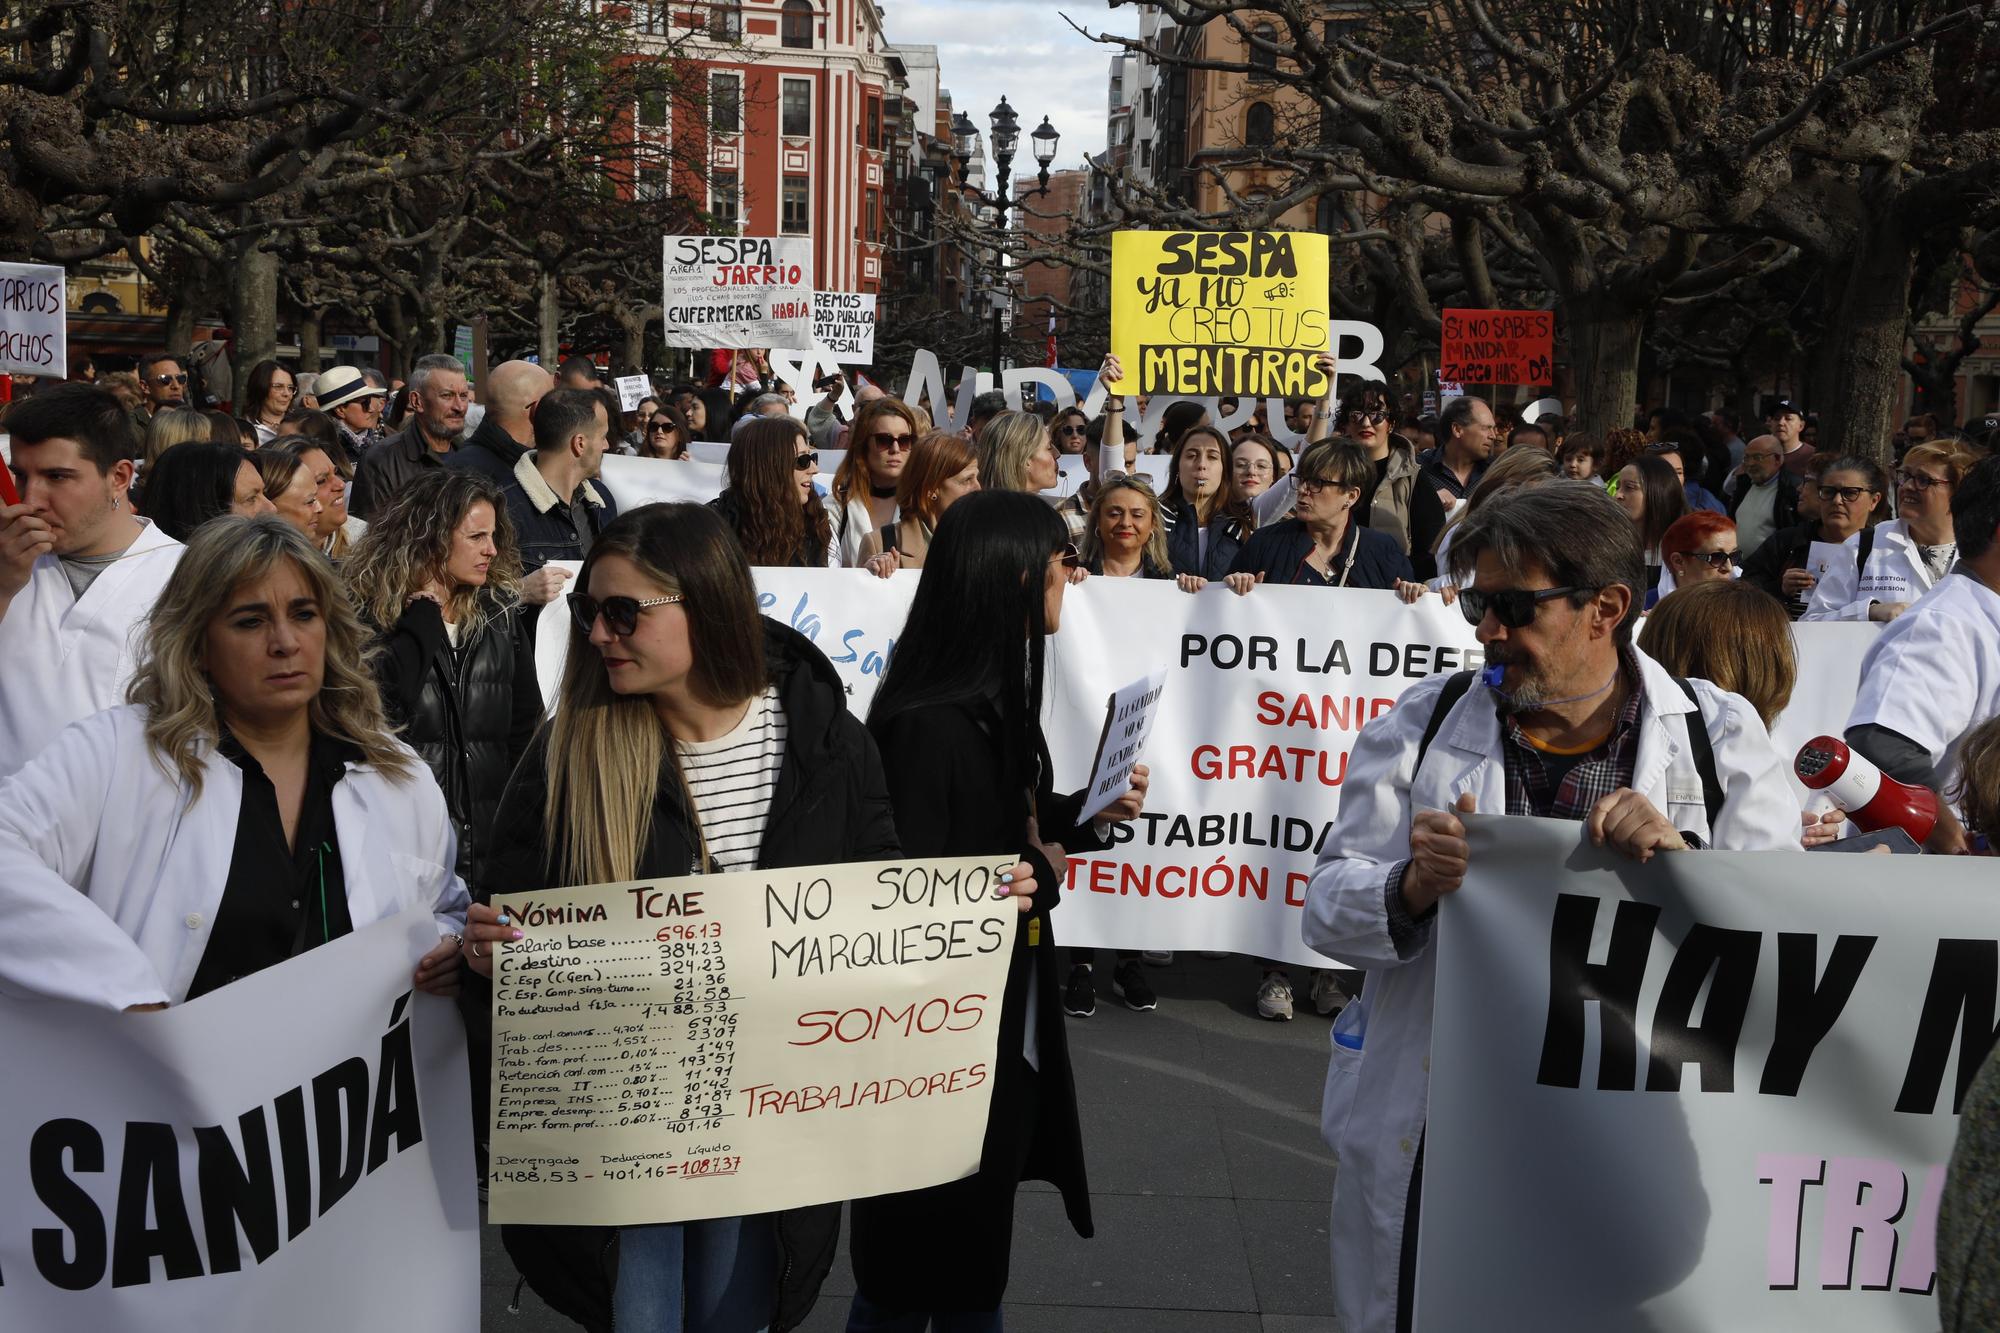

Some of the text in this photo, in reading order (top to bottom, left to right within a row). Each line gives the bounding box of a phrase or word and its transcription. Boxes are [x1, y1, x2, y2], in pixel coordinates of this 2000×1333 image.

[674, 238, 773, 266] SESPA
[1156, 232, 1298, 278] SESPA
[669, 264, 695, 275] AREA
[0, 279, 59, 314] ARIOS
[673, 287, 688, 295] LOS
[814, 293, 861, 308] REMOS
[1137, 276, 1248, 314] ya no
[669, 297, 810, 324] ENFERMERAS HABÍA
[815, 308, 874, 324] DAD PUBLICA
[1169, 306, 1327, 348] CREO TUS
[1468, 319, 1489, 338] NO
[1492, 315, 1549, 339] SABES
[822, 339, 862, 353] RSAL
[1495, 363, 1519, 382] HAS
[790, 591, 822, 642] la
[1180, 633, 1279, 672] POR
[1296, 637, 1352, 676] LA
[1191, 744, 1347, 786] GRATU
[766, 862, 1015, 928] NO SOMOS
[1065, 855, 1269, 901] TENCIÓN
[627, 886, 705, 920] TCAE
[501, 938, 562, 955] Salario
[567, 934, 606, 950] base
[772, 918, 1005, 979] MARQUESES
[1536, 892, 1879, 1097] HAY
[787, 994, 987, 1046] SOMOS
[499, 1069, 561, 1081] Retención
[500, 1083, 561, 1096] Empresa
[571, 1081, 592, 1092] IT
[740, 1063, 986, 1118] TRABAJADORES
[498, 1096, 557, 1109] Empresa
[30, 989, 423, 1291] SANIDÁ
[496, 1142, 731, 1166] Devengado Deducciones Líquido
